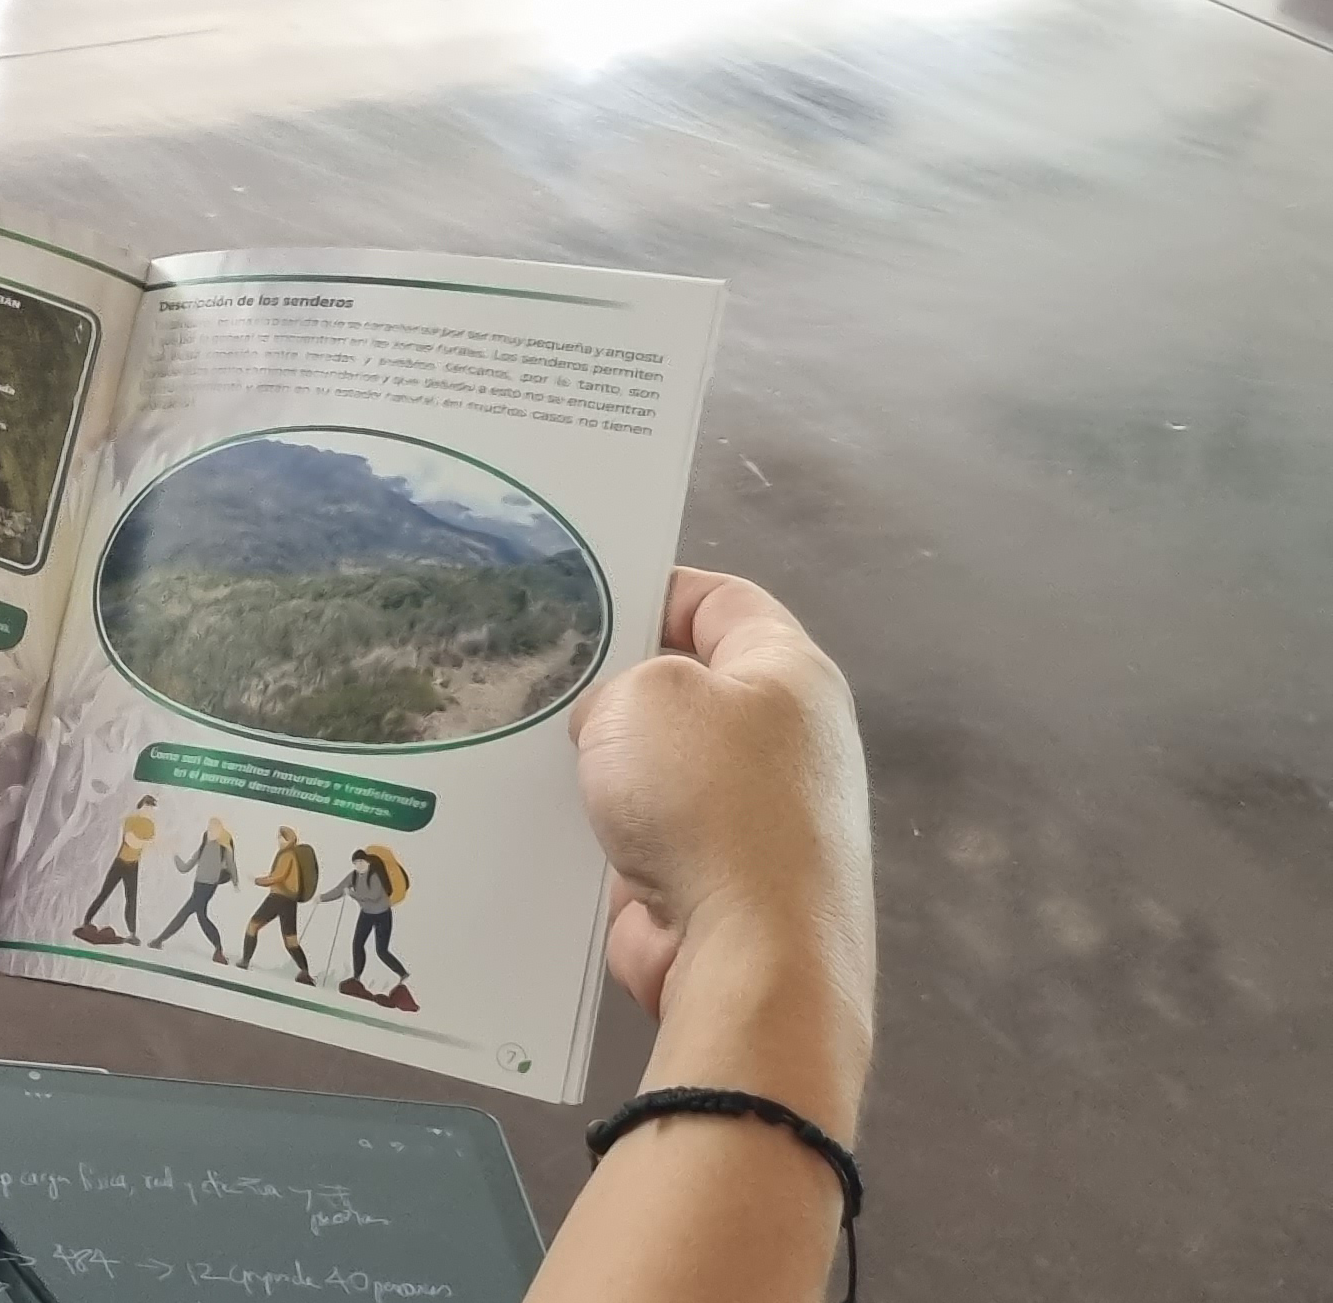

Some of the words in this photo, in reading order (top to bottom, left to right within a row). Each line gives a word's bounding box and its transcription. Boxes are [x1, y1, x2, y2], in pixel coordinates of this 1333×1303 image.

[159, 295, 233, 313] Descripción
[237, 295, 255, 308] de
[259, 295, 279, 308] los
[282, 296, 353, 309] senderos
[492, 335, 522, 348] muy
[526, 335, 592, 356] pequeña
[594, 347, 605, 357] y
[494, 350, 517, 361] Los
[521, 353, 589, 372] senderos
[592, 363, 664, 385] permiten
[519, 374, 548, 387] por
[578, 379, 622, 397] tanto,
[628, 389, 659, 400] son
[490, 385, 520, 397] esto
[525, 392, 543, 401] no
[567, 395, 656, 417] encuentran
[532, 411, 572, 423] casos
[578, 418, 597, 427] no
[602, 419, 652, 435] tienen
[149, 745, 180, 763] Como
[273, 770, 331, 789] naturales
[343, 783, 428, 809] tradicionales
[249, 778, 331, 804] denominados
[506, 1049, 517, 1064] 7
